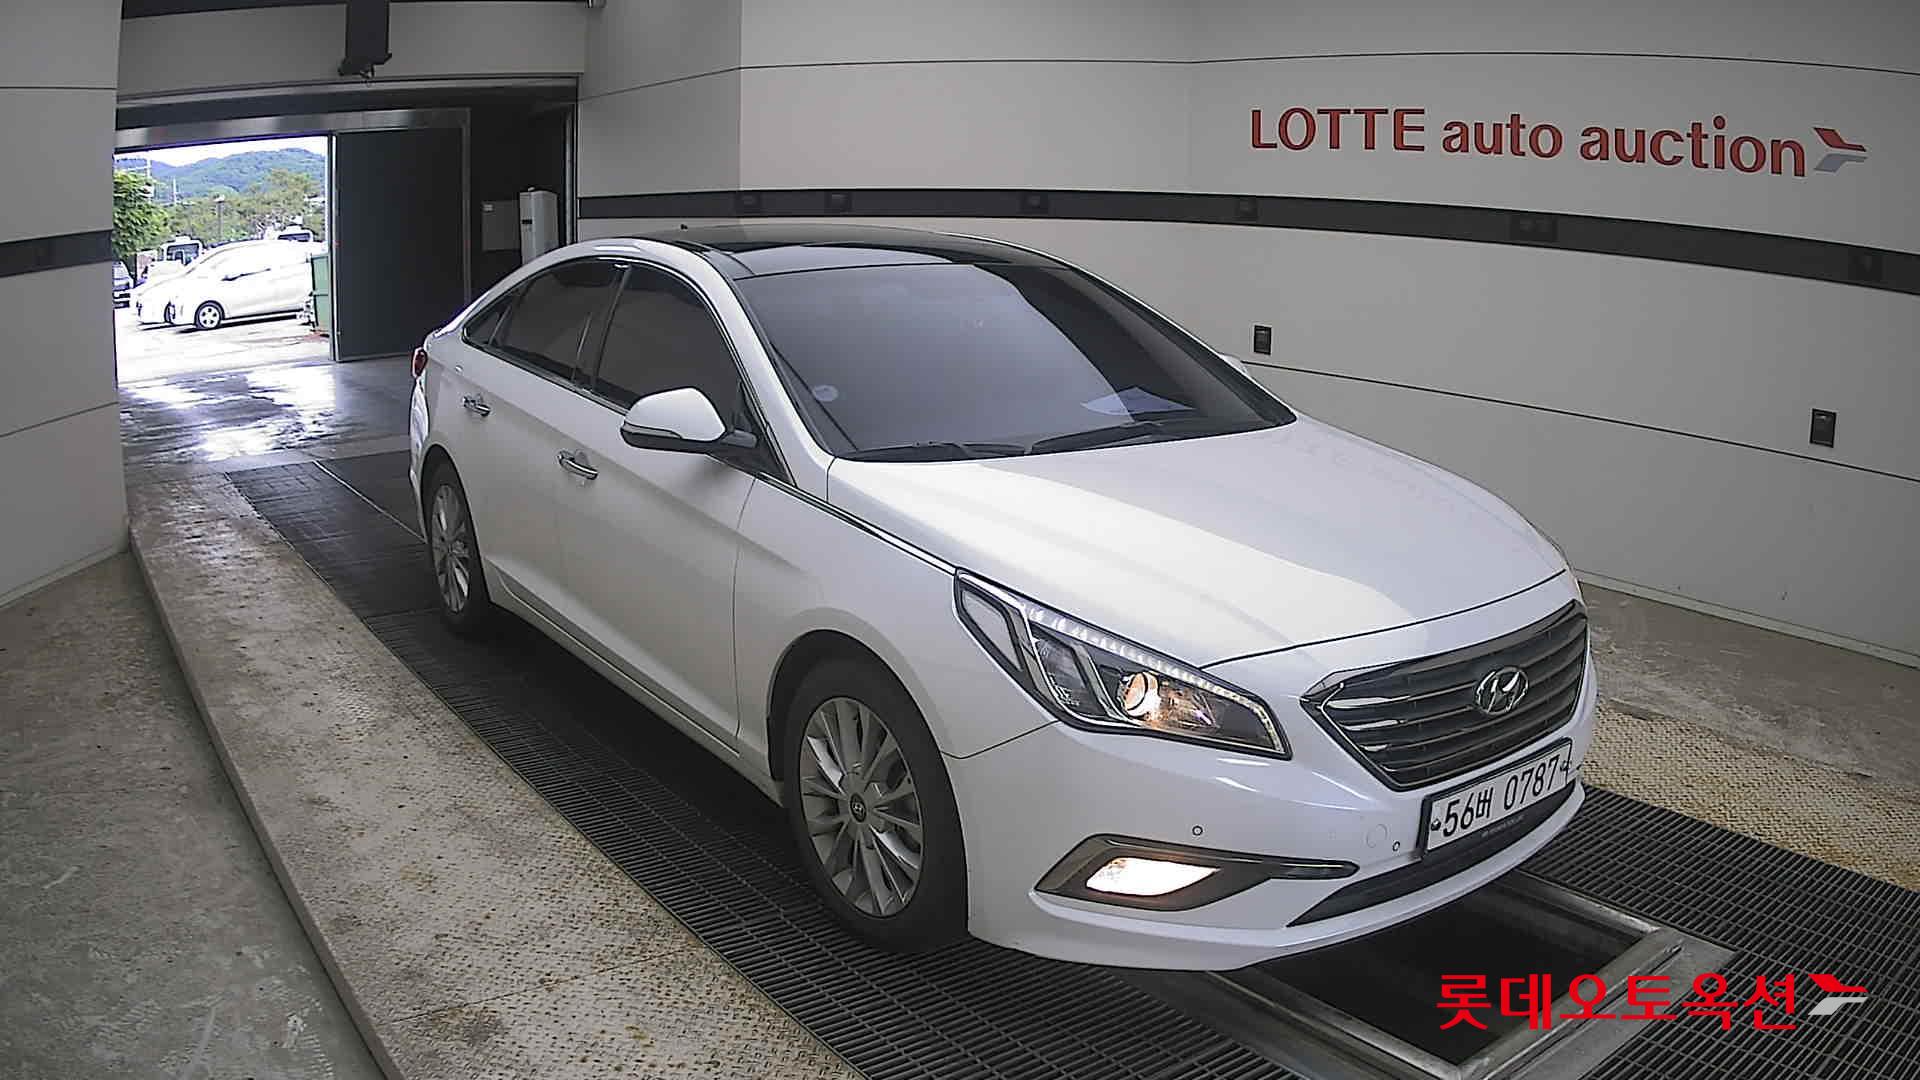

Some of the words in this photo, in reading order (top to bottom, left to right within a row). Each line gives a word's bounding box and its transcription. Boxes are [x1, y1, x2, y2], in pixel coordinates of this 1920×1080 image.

[1251, 107, 1425, 151] LOTTE
[1442, 113, 1563, 158] auto
[1580, 116, 1805, 177] auction
[1443, 787, 1494, 837] 56버
[1504, 754, 1560, 811] 0787
